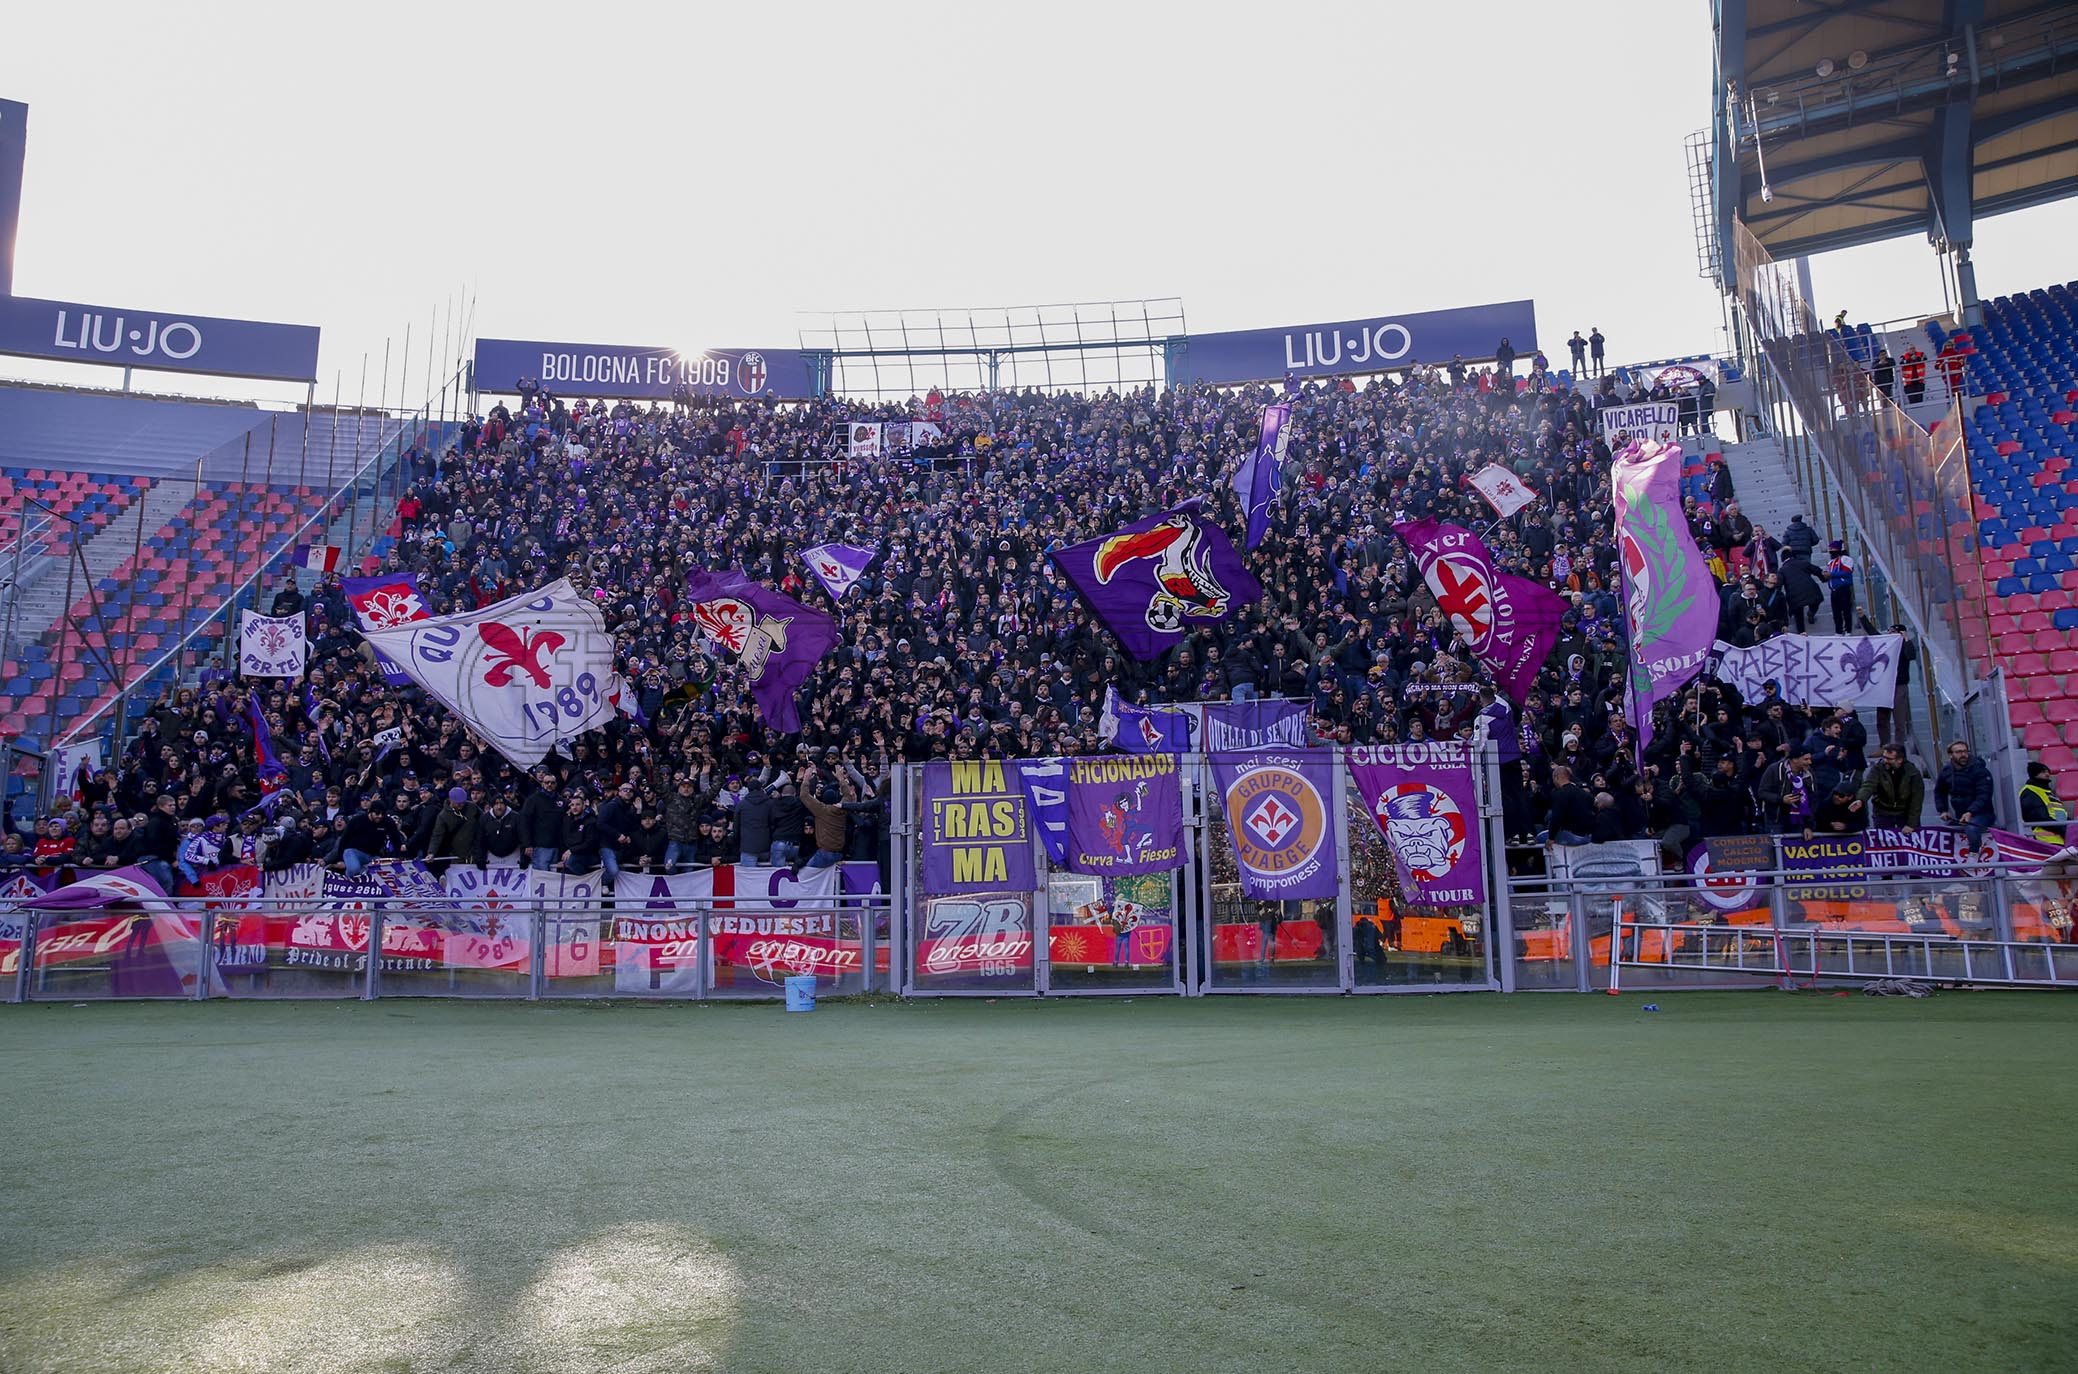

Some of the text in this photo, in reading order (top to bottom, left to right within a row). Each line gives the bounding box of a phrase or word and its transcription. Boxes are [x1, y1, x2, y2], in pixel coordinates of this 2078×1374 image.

[542, 353, 640, 384] BOLOGNA
[646, 357, 672, 385] FC
[1605, 406, 1677, 430] VICARELLO
[243, 653, 273, 674] PER
[1250, 729, 1264, 747] DI
[1235, 754, 1305, 774] mai scesi
[1352, 740, 1466, 771] CICLONE
[1429, 762, 1468, 771] VIOLA
[951, 759, 1007, 794] MA
[1238, 773, 1304, 798] GRUPPO
[945, 801, 1015, 838] RAS
[1784, 842, 1862, 859] VACILLO
[1866, 829, 1952, 853] FIRENZE
[952, 847, 1008, 883] MA
[1241, 840, 1311, 870] PIAGGE
[1249, 857, 1322, 893] ompromessi
[1429, 888, 1475, 903] TOUR
[1787, 886, 1866, 900] CROLLO
[285, 945, 330, 969] Pride
[333, 953, 350, 970] of
[466, 935, 514, 961] 1989
[978, 960, 1016, 977] 1965
